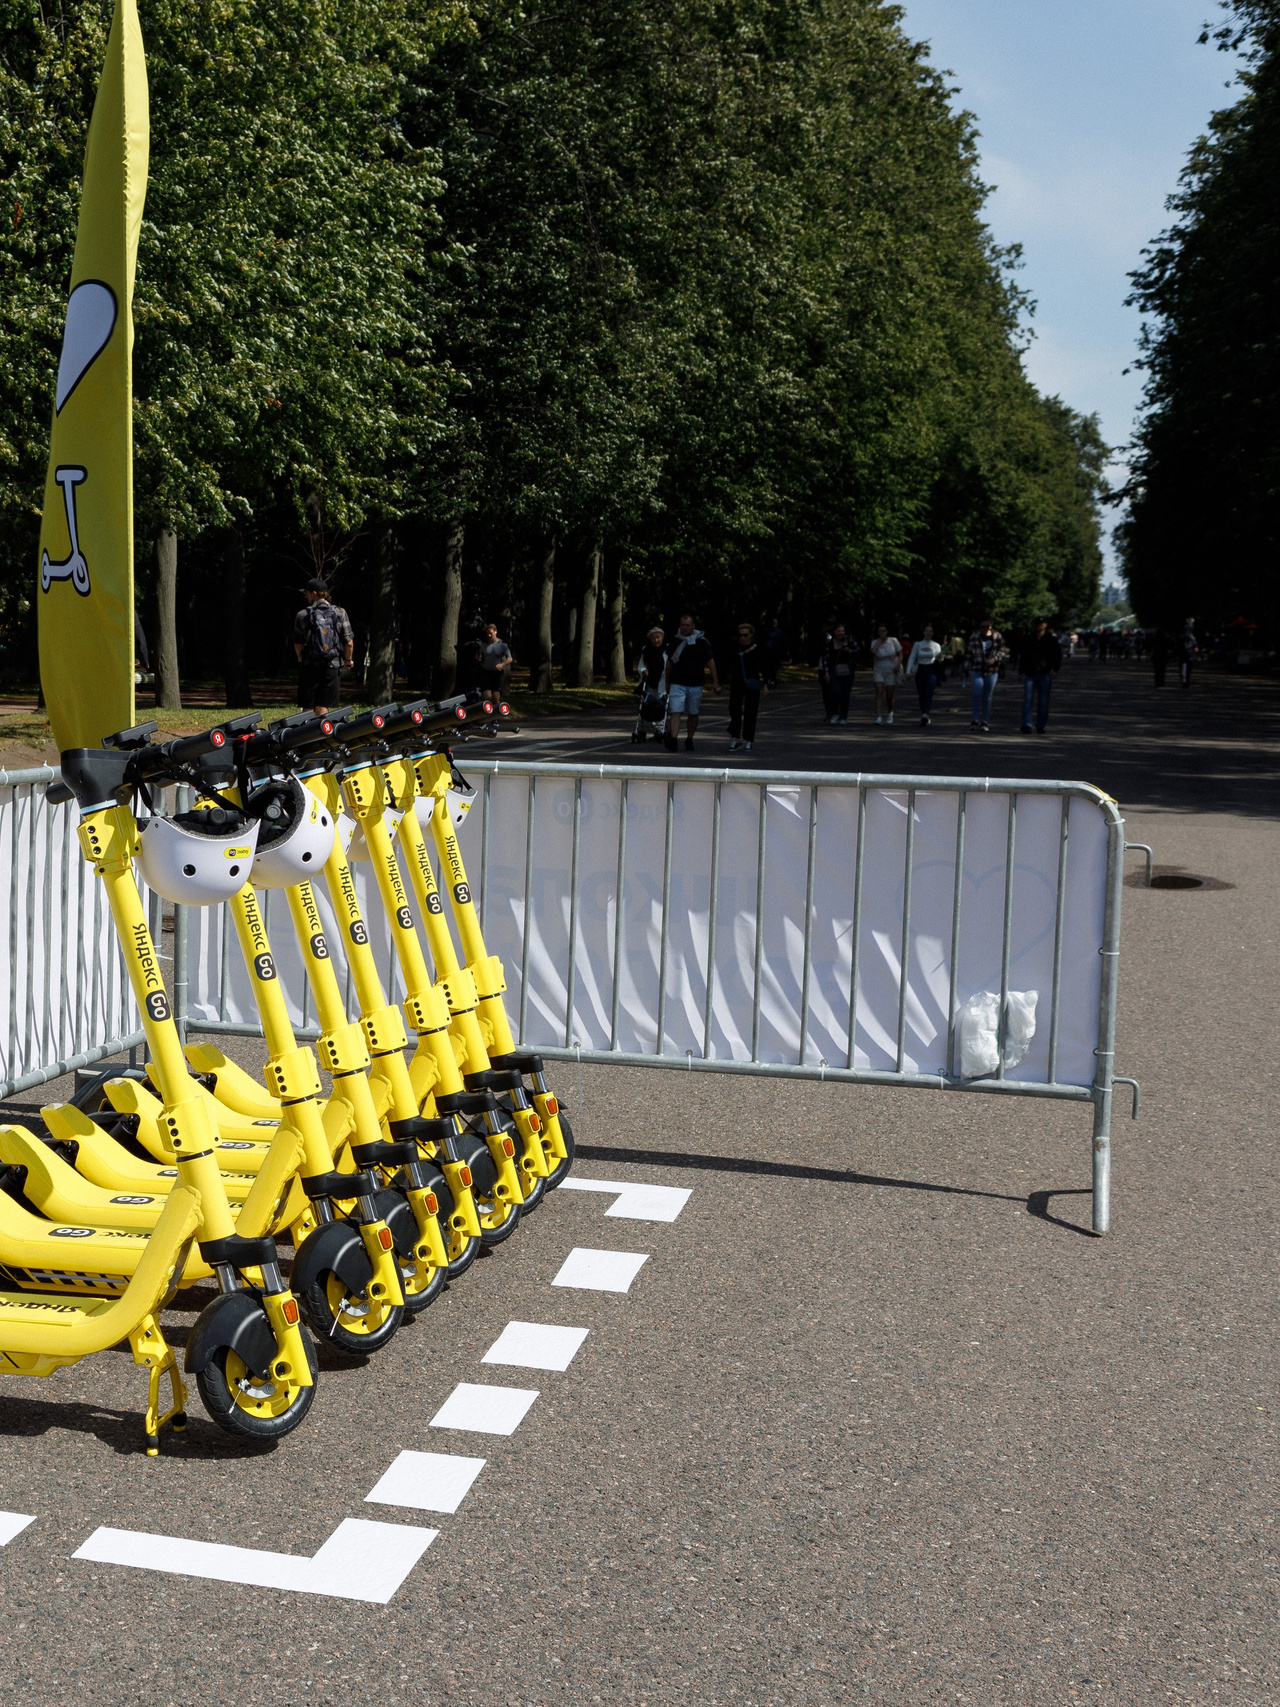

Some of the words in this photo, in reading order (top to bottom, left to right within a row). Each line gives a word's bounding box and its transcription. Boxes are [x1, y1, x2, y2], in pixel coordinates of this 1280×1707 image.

[386, 854, 406, 903] Яндекс
[399, 907, 412, 928] Go
[416, 843, 435, 889] Яндекс
[429, 893, 441, 913] Go
[445, 835, 463, 880] Яндекс
[456, 884, 469, 903] Go
[242, 892, 266, 950] Яндекс
[258, 955, 273, 979] Go
[338, 866, 359, 917] Яндекс
[353, 922, 366, 943] Go
[132, 923, 159, 988] Яндекс
[150, 992, 168, 1019] Go
[314, 935, 327, 957] Go
[56, 1228, 92, 1237] Go
[115, 1196, 150, 1204] Go
